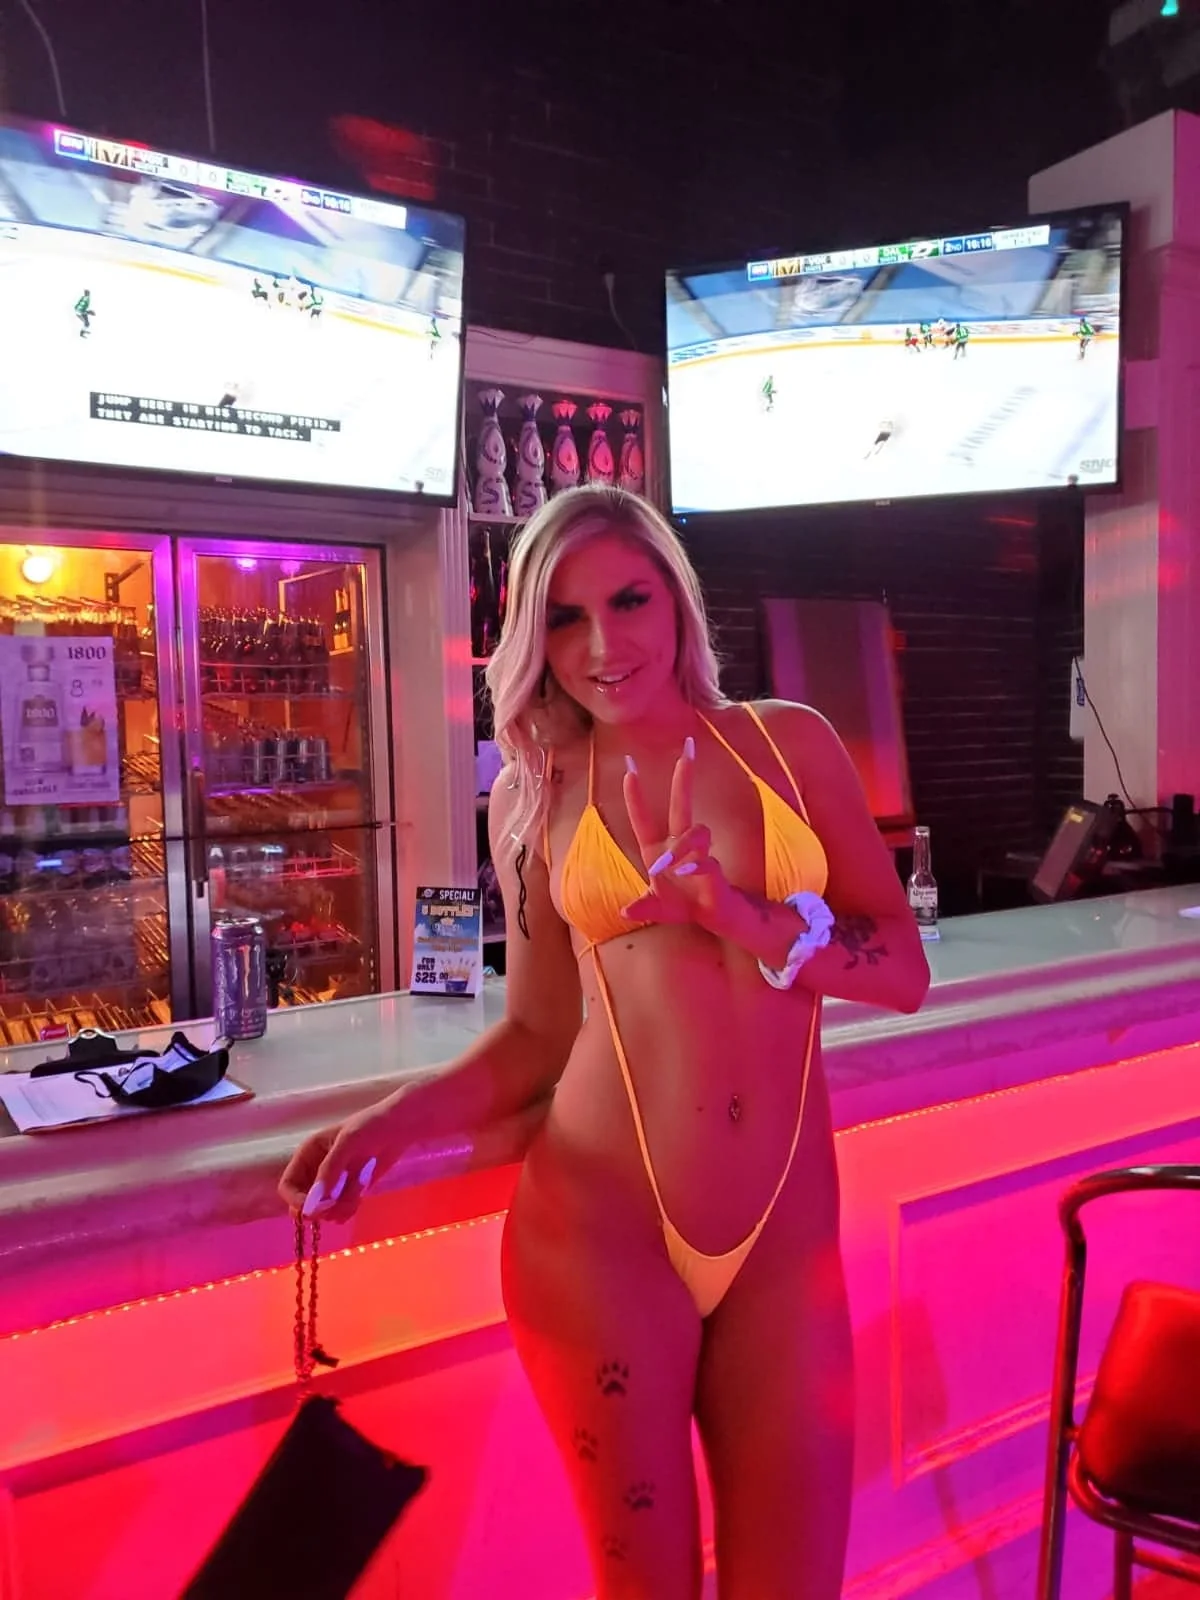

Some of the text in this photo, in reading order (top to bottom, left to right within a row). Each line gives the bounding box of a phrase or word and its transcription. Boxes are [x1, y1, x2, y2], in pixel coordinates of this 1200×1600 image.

[97, 394, 133, 406] JUMP
[139, 399, 174, 412] HERE
[182, 403, 199, 415] IN
[204, 406, 231, 418] HIS
[237, 410, 285, 426] SECOND
[97, 407, 133, 421] THEY
[139, 413, 165, 426] ARE
[172, 416, 239, 433] STARTING
[244, 423, 262, 435] TO
[67, 646, 107, 660] 1800
[70, 679, 84, 698] 8
[439, 889, 475, 901] SPECIAL!
[421, 956, 436, 964] FOR
[416, 963, 436, 972] ONLY
